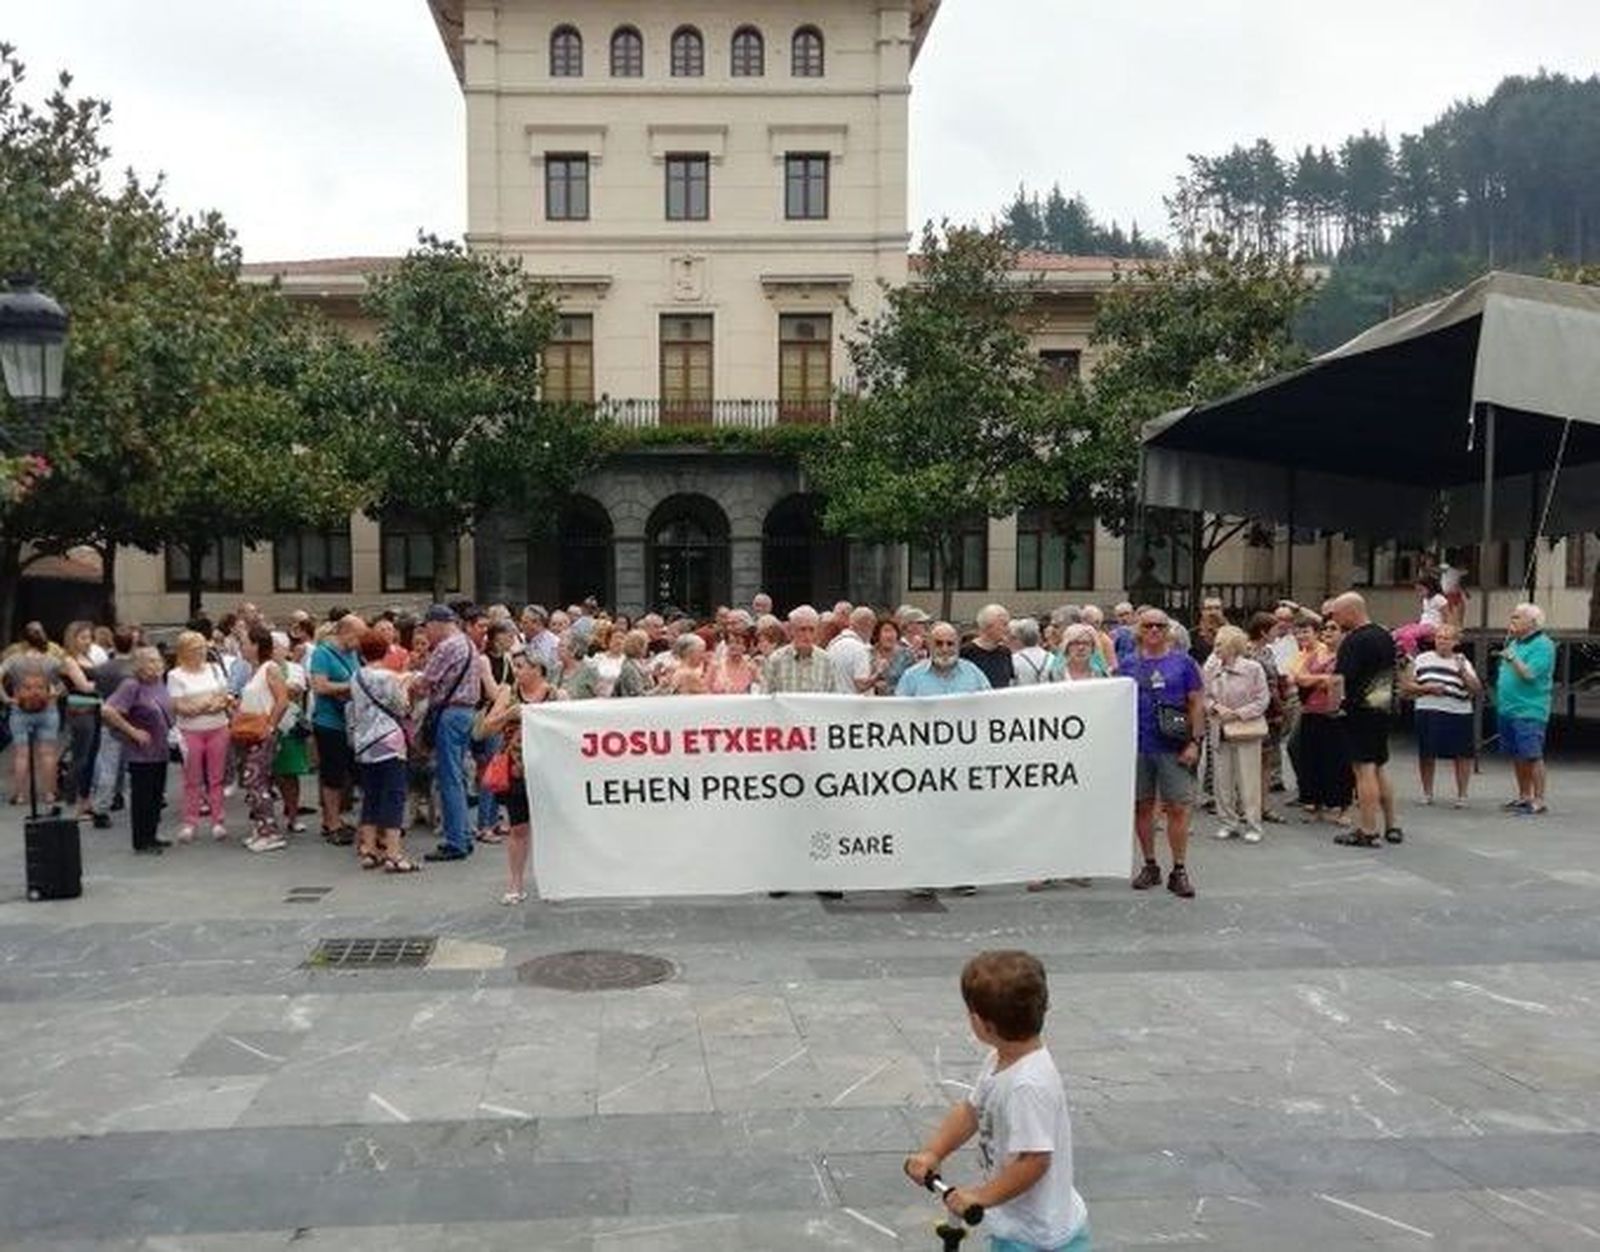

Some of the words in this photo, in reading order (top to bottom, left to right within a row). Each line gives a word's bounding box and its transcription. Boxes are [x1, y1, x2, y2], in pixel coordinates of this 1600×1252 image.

[580, 730, 672, 757] JOSU
[682, 727, 817, 754] ETXERA!
[827, 720, 977, 748] BERANDU
[988, 715, 1086, 743] BAINO
[585, 777, 691, 804] LEHEN
[701, 773, 806, 800] PRESO
[814, 768, 959, 797] GAIXOAK
[968, 762, 1079, 790] ETXERA
[838, 834, 894, 856] SARE
